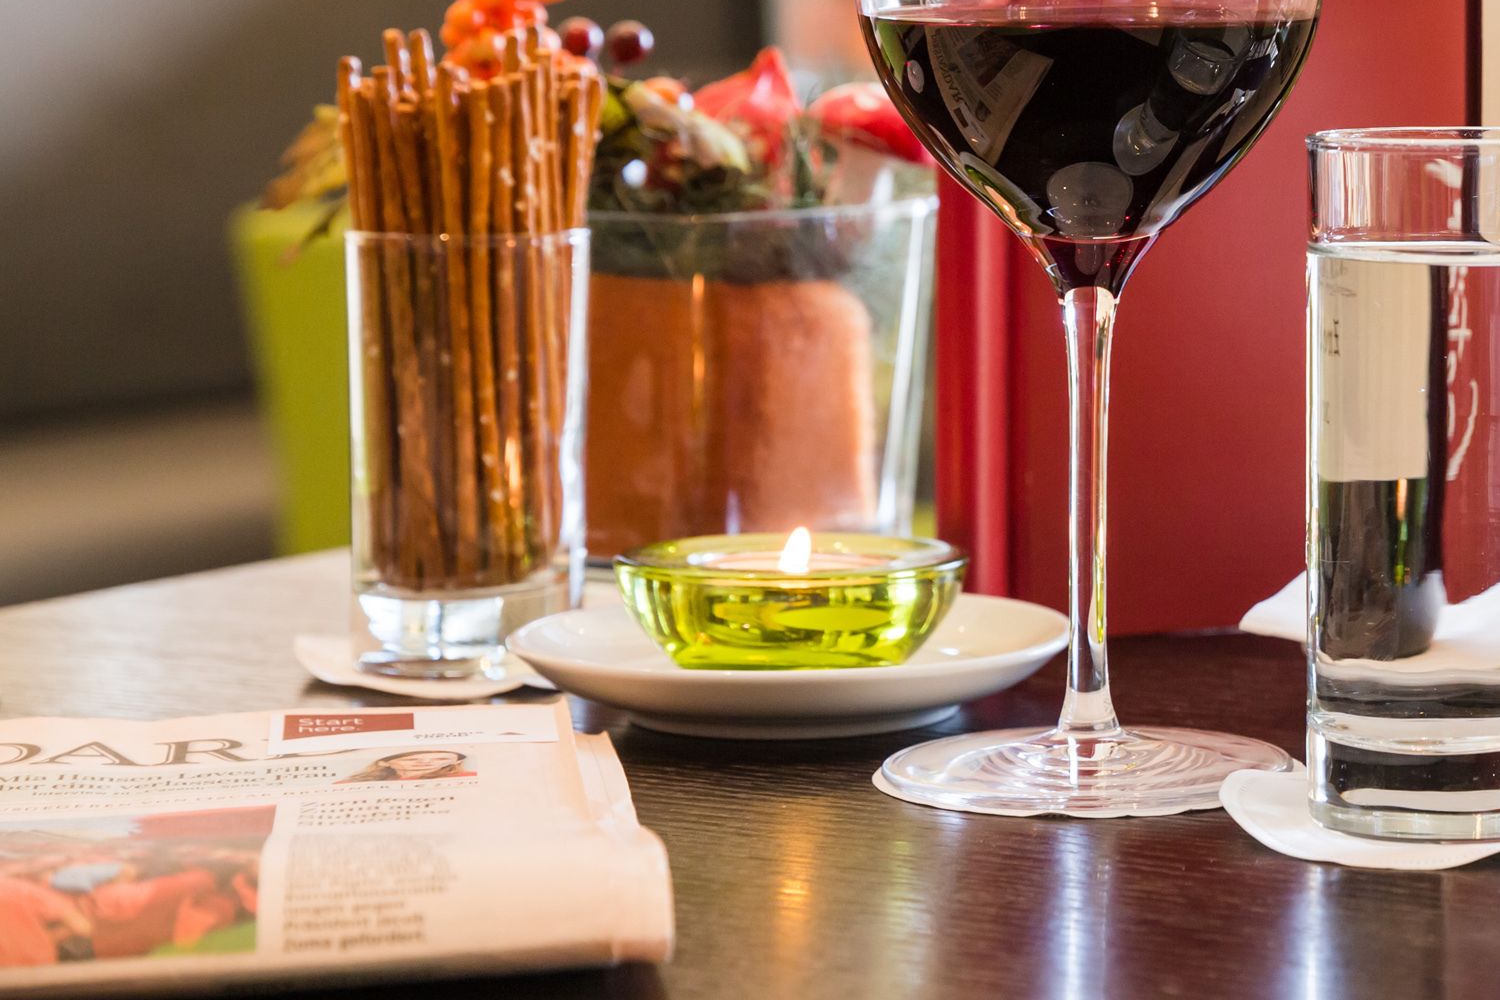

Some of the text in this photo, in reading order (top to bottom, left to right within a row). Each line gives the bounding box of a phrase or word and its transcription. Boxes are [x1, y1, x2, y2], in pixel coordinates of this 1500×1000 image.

[299, 717, 364, 726] Start
[299, 725, 361, 733] here.
[265, 765, 328, 775] Film
[52, 782, 112, 791] eine
[275, 771, 336, 782] Frau
